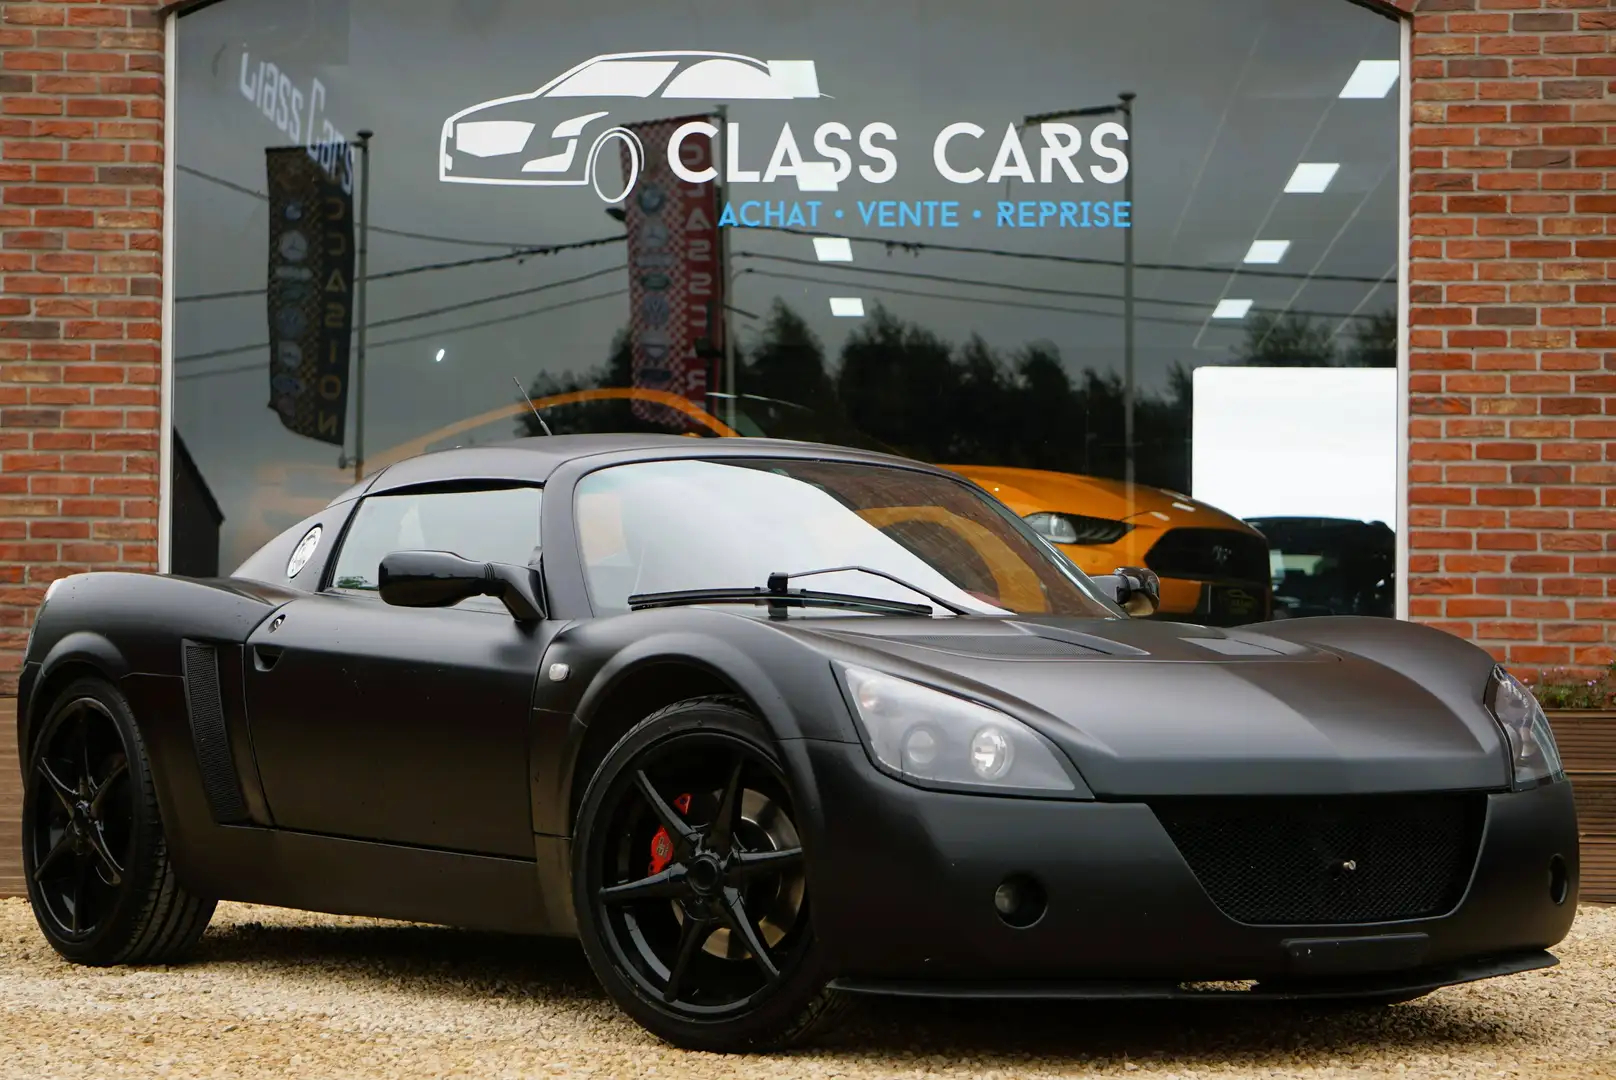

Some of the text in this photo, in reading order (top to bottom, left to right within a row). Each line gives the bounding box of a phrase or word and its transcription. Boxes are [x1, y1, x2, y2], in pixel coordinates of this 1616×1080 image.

[306, 77, 355, 196] Cars
[667, 121, 1130, 184] CLASS CARS
[717, 200, 1133, 228] ACHAT VENTE REPRISE
